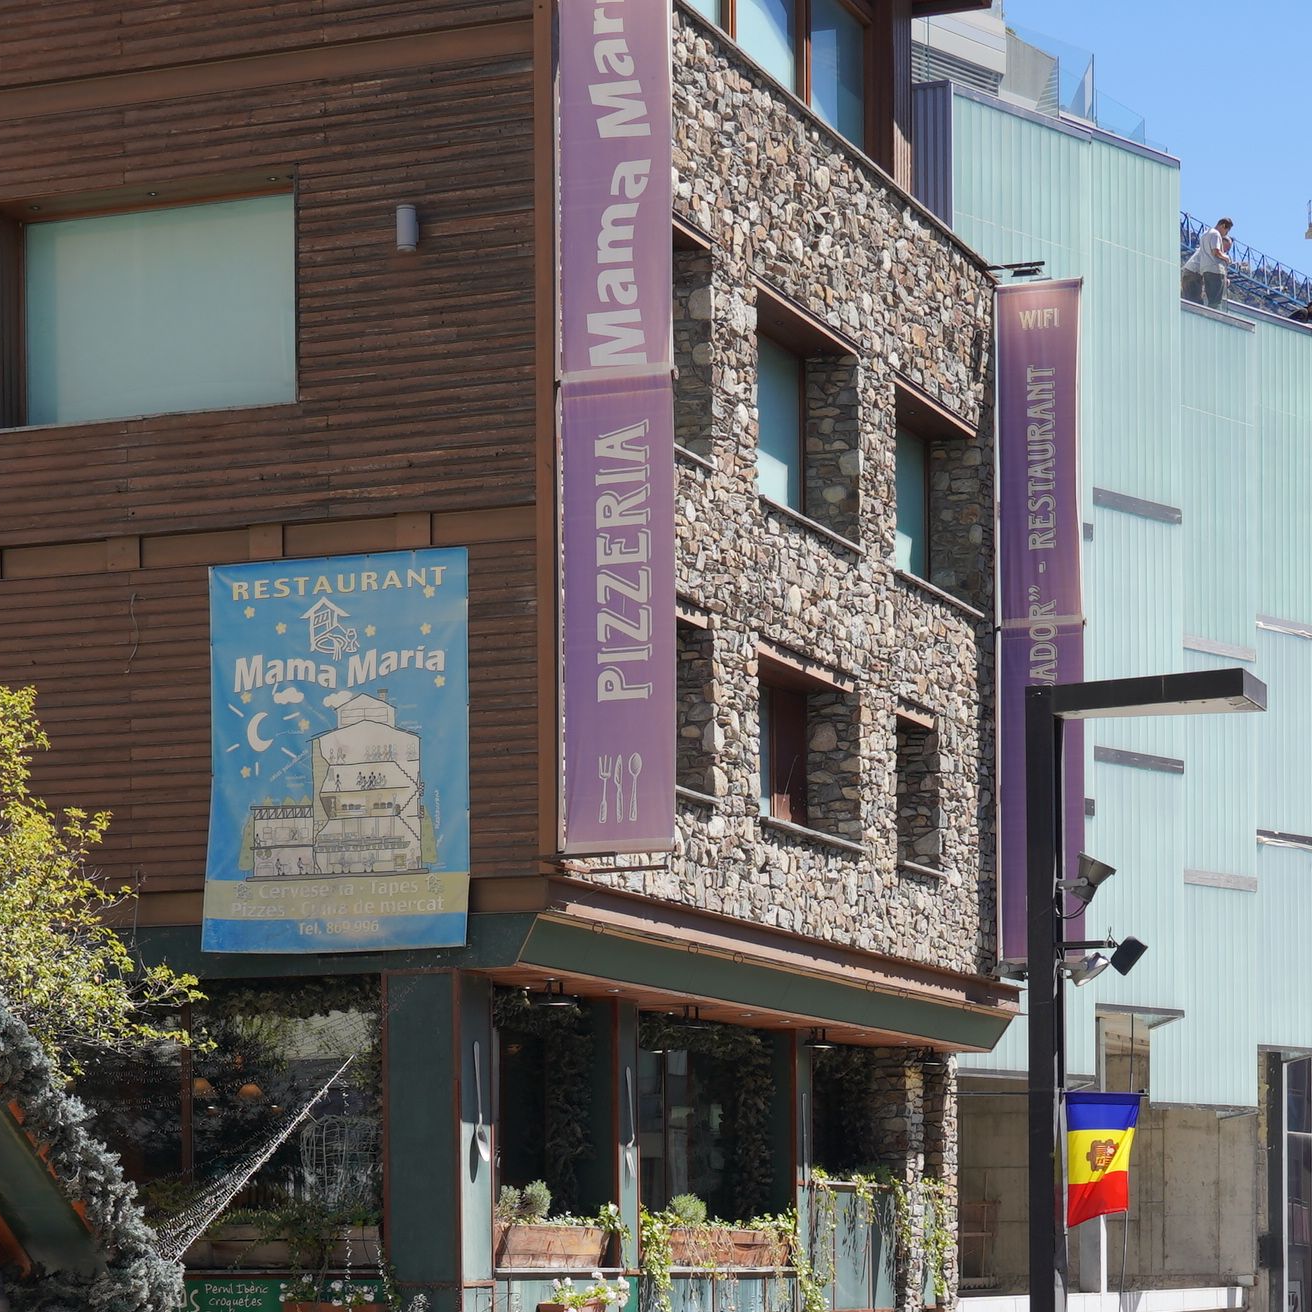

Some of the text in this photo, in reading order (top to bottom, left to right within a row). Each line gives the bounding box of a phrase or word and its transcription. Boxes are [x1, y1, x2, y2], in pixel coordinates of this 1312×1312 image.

[587, 0, 652, 367] Mama Mar
[1019, 308, 1060, 329] WIFI
[1026, 364, 1056, 551] RESTAURANT
[595, 418, 653, 703] PIZZERIA
[232, 565, 448, 601] RESTAURANT
[234, 654, 337, 693] Mama
[371, 879, 418, 897] Tapes
[231, 902, 285, 917] Pizzes
[353, 899, 373, 914] de
[380, 896, 445, 913] mercat
[298, 922, 322, 936] Tel.
[354, 920, 380, 933] 996
[205, 1283, 234, 1294] Pernil
[208, 1294, 263, 1312] croquetes
